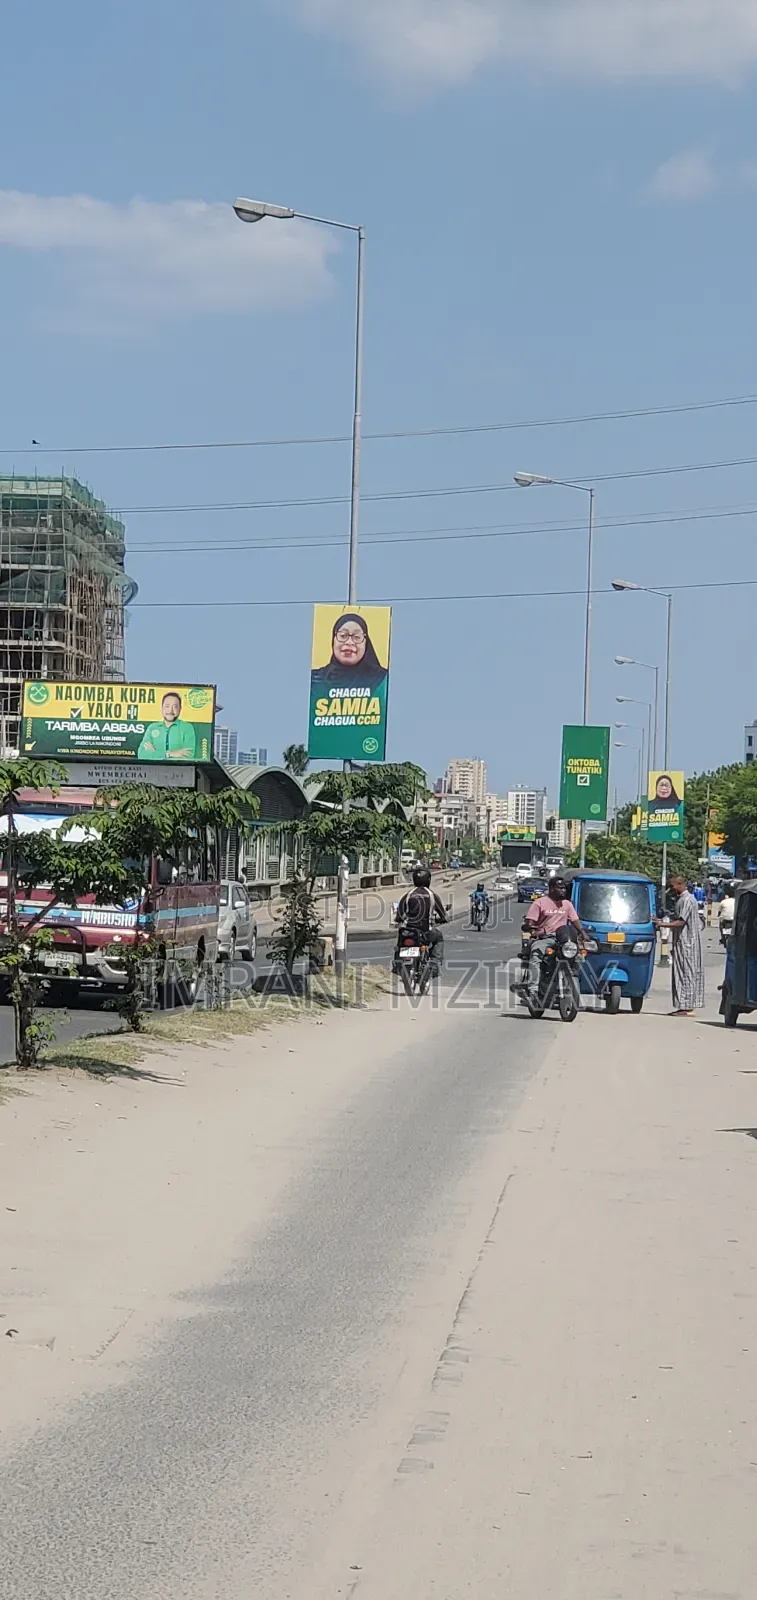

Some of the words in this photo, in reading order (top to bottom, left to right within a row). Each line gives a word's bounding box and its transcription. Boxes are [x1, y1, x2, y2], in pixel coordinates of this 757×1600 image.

[55, 685, 115, 702] NAOMBA
[120, 687, 156, 704] KURA
[329, 687, 371, 698] CHAGUA
[87, 702, 122, 718] YAKO
[314, 697, 380, 716] SAMIA
[314, 716, 356, 726] CHAGUA
[356, 715, 381, 725] CCM
[45, 720, 100, 732] TARIMBA
[101, 723, 145, 734] ABBAS
[567, 758, 600, 767] OKTOBA
[87, 771, 147, 779] MWEMBECHAI
[566, 766, 602, 774] TUNATIKI
[648, 813, 680, 822] SAMIA
